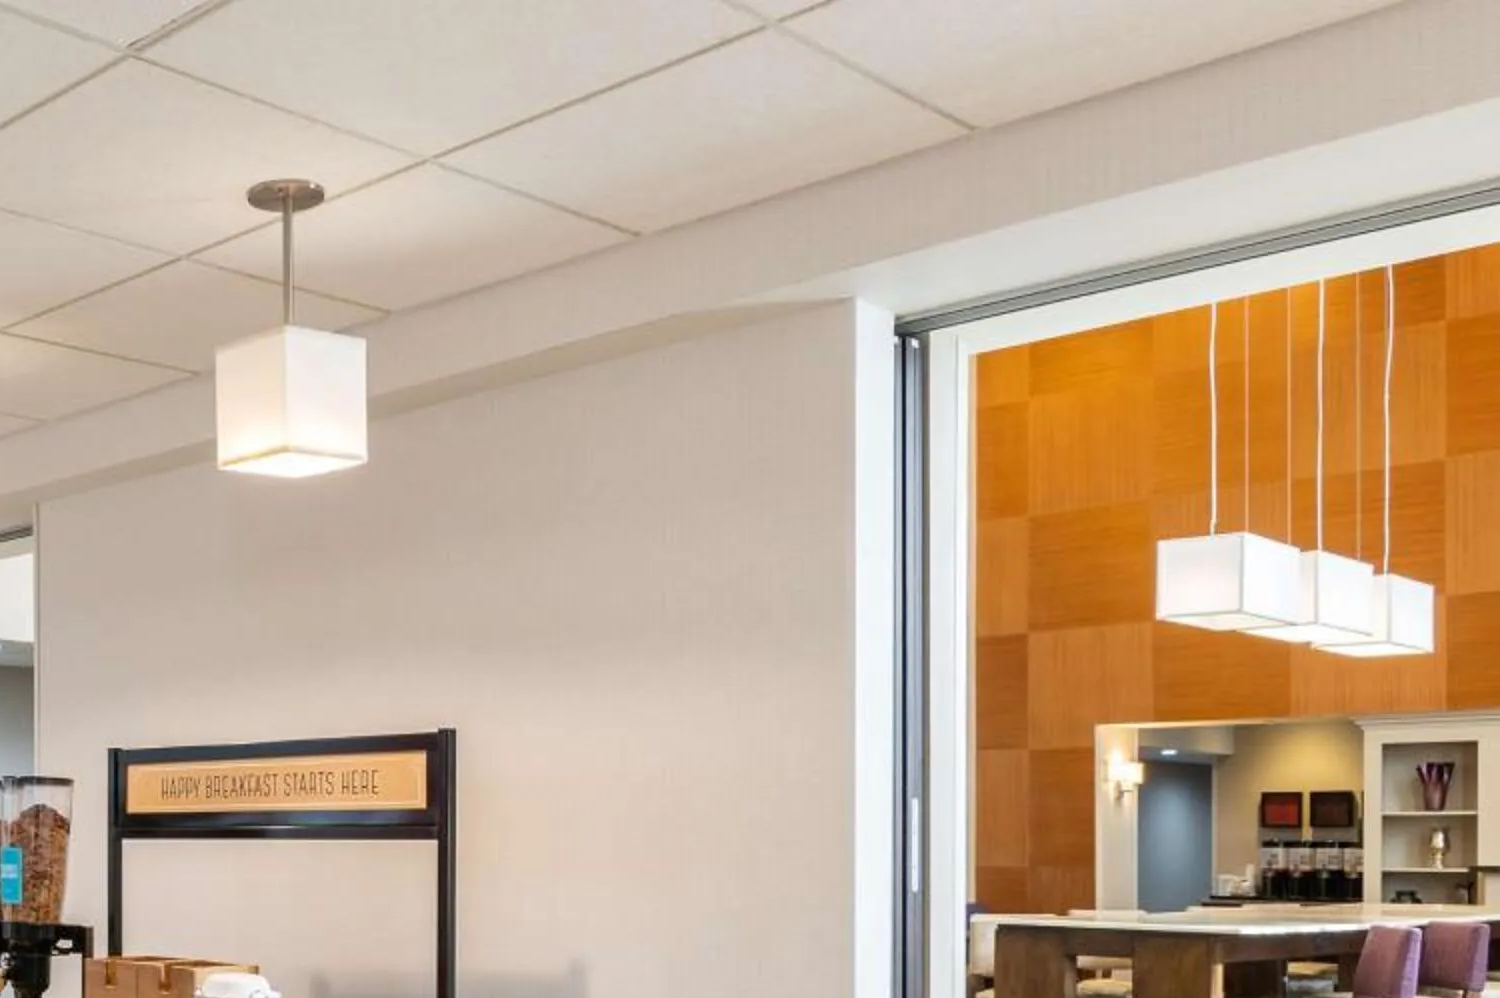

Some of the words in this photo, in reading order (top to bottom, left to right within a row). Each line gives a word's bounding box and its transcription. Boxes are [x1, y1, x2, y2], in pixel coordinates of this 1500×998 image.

[161, 774, 201, 800] HAPPY
[205, 773, 278, 800] BREAKFAST
[283, 771, 334, 797] STARTS
[341, 769, 379, 796] HERE
